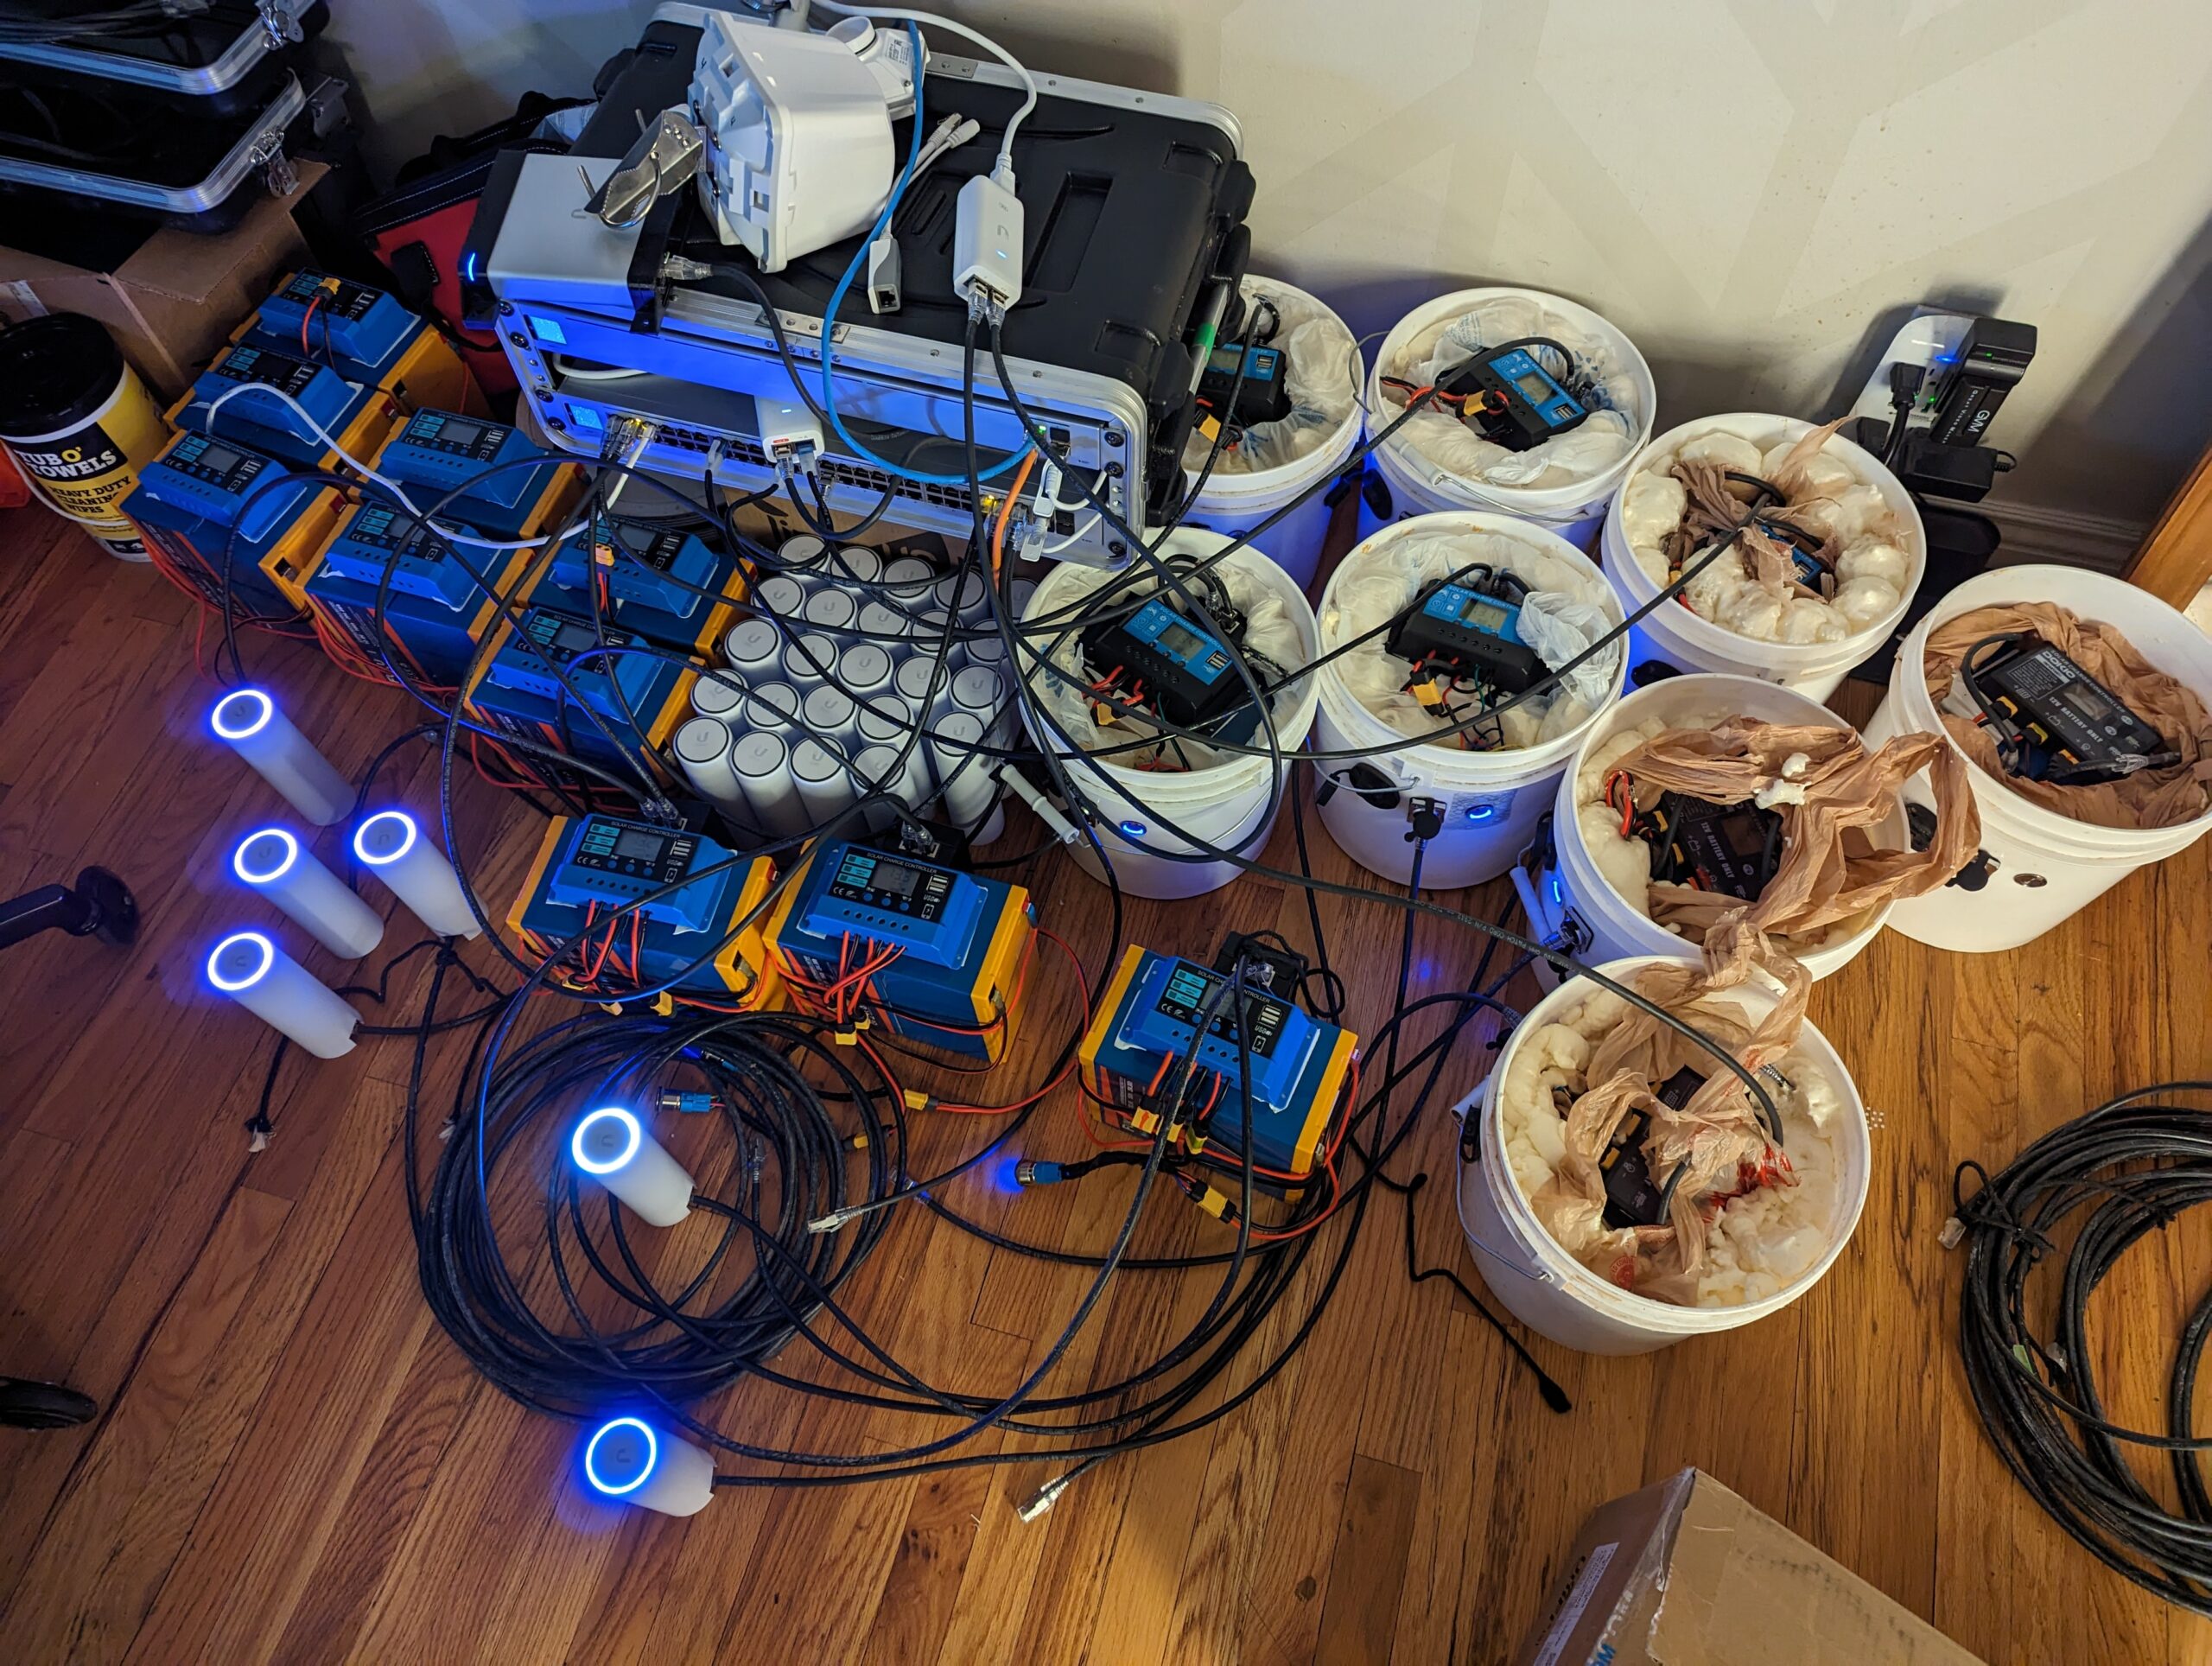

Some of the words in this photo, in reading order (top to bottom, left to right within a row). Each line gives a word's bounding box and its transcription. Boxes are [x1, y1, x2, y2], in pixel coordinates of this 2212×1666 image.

[13, 448, 62, 466] TUB
[25, 449, 117, 477] TOWELS
[93, 476, 130, 495] DUTY
[58, 493, 118, 506] CLEANIN
[2042, 651, 2075, 679] DOKIO
[2049, 696, 2062, 707] 12V
[2060, 707, 2088, 729] BATTERY
[2087, 729, 2104, 743] ONLY
